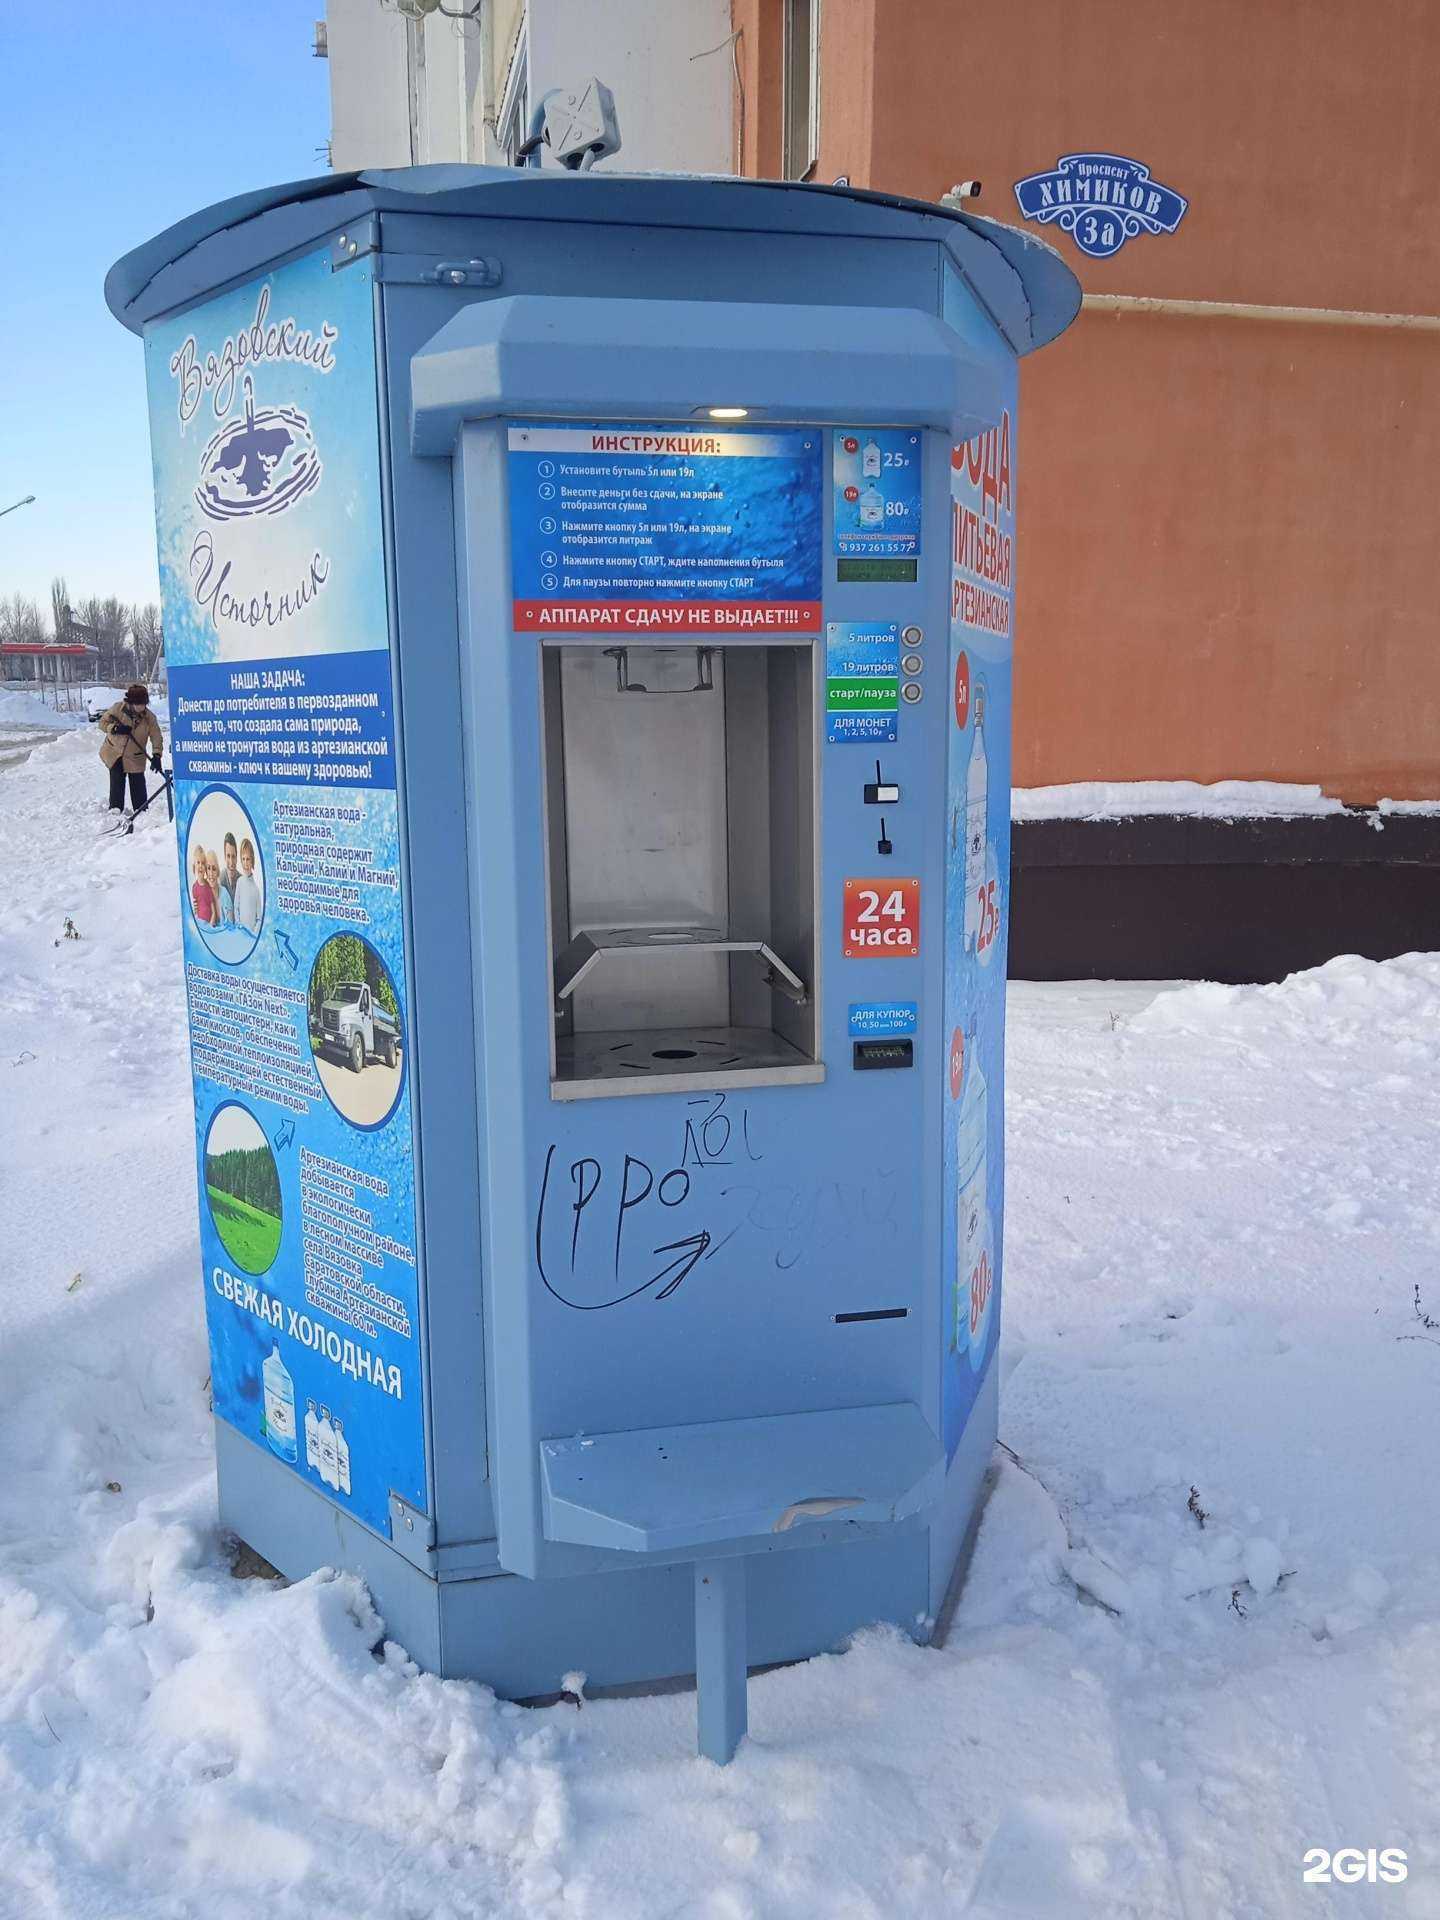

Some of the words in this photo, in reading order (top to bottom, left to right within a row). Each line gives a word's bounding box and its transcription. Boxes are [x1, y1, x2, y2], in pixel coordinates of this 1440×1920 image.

[1077, 162, 1130, 180] Проспект
[1039, 178, 1162, 215] ХИМИКОВ
[1083, 216, 1115, 246] 3а
[172, 288, 335, 424] Вязовский
[592, 435, 721, 455] ИНСТРУКЦИЯ:
[560, 464, 610, 477] Установите
[612, 465, 646, 478] бутыль
[648, 466, 659, 477] 5л
[660, 468, 677, 477] или
[679, 467, 695, 477] 19л
[561, 487, 597, 497] Внесите
[599, 488, 631, 500] деньги
[633, 488, 648, 498] без
[650, 490, 678, 500] сдачи,
[692, 492, 724, 502] экране
[561, 500, 617, 512] отобразится
[618, 502, 647, 512] сумма
[562, 521, 603, 531] Нажмите
[605, 523, 636, 533] кнопку
[638, 522, 649, 532] 5л
[650, 523, 667, 532] или
[670, 522, 687, 533] 19л,
[689, 524, 700, 533] на
[700, 525, 732, 535] экране
[562, 534, 617, 546] отобразится
[619, 535, 652, 545] литраж
[849, 543, 866, 552] 937
[868, 543, 885, 552] 261
[887, 543, 899, 552] 55
[562, 555, 604, 566] Нажмите
[606, 557, 637, 568] кнопку
[639, 555, 667, 567] СТАРТ,
[668, 557, 696, 568] ждите
[698, 558, 750, 567] наполнения
[752, 556, 784, 569] бутыля
[190, 530, 329, 627] Источник
[563, 577, 581, 588] Для
[583, 578, 611, 590] паузы
[613, 578, 655, 589] повторно
[656, 579, 696, 588] нажмите
[698, 579, 728, 590] кнопку
[729, 577, 754, 588] СТАРТ
[952, 578, 1009, 634] РТЕЗИАНСКАЯ
[539, 608, 622, 624] АППАРАТ
[625, 608, 684, 626] СДАЧУ
[688, 609, 710, 624] НЕ
[714, 609, 799, 627] ВЫДАЕТ!!!
[848, 633, 855, 642] 5
[857, 634, 895, 644] литров
[842, 662, 855, 671] 19
[856, 663, 894, 673] литров
[230, 672, 260, 690] НАША
[261, 669, 305, 691] ЗАДАЧА:
[829, 688, 897, 700] старт/пауза
[178, 697, 213, 715] Донести
[214, 698, 225, 714] до
[226, 694, 287, 717] потребителя
[289, 697, 295, 708] в
[297, 693, 378, 712] первозданном
[192, 720, 212, 735] виде
[213, 720, 226, 734] то,
[227, 720, 243, 732] что
[245, 719, 282, 735] создала
[285, 718, 309, 732] сама
[311, 718, 362, 736] природа,
[834, 718, 855, 729] ДЛЯ
[856, 718, 892, 728] МОНЕТ
[175, 742, 181, 752] а
[181, 741, 214, 752] именно
[215, 741, 226, 753] не
[227, 741, 270, 757] тронутая
[271, 741, 295, 756] вода
[297, 741, 310, 753] из
[311, 737, 388, 758] артезианской
[188, 761, 232, 773] скважины
[239, 761, 262, 774] ключ
[264, 763, 270, 775] к
[272, 762, 312, 780] вашему
[313, 761, 372, 781] здоровью!
[273, 801, 335, 819] Артезианская
[337, 808, 361, 823] вода
[274, 823, 335, 840] натуральная,
[275, 841, 325, 858] природная
[326, 846, 372, 862] содержит
[276, 857, 318, 877] Кальций,
[319, 861, 348, 878] Калий
[349, 869, 356, 880] и
[358, 866, 398, 888] Магний,
[277, 877, 340, 898] необходимые
[341, 886, 359, 901] для
[278, 897, 321, 914] здоровья
[323, 905, 370, 922] человека.
[857, 890, 906, 923] 24
[850, 927, 912, 946] часа
[188, 964, 220, 982] Доставка
[221, 974, 241, 989] воды
[241, 980, 306, 1004] осуществляется
[855, 1010, 875, 1021] ДЛЯ
[876, 1009, 911, 1019] КУПЮР
[300, 1148, 363, 1182] Артезианская
[364, 1174, 389, 1195] вода
[301, 1168, 354, 1198] добывается
[302, 1201, 377, 1242] благополучном
[213, 1267, 284, 1330] СВЕЖАЯ
[288, 1307, 402, 1400] ХОЛОДНАЯ
